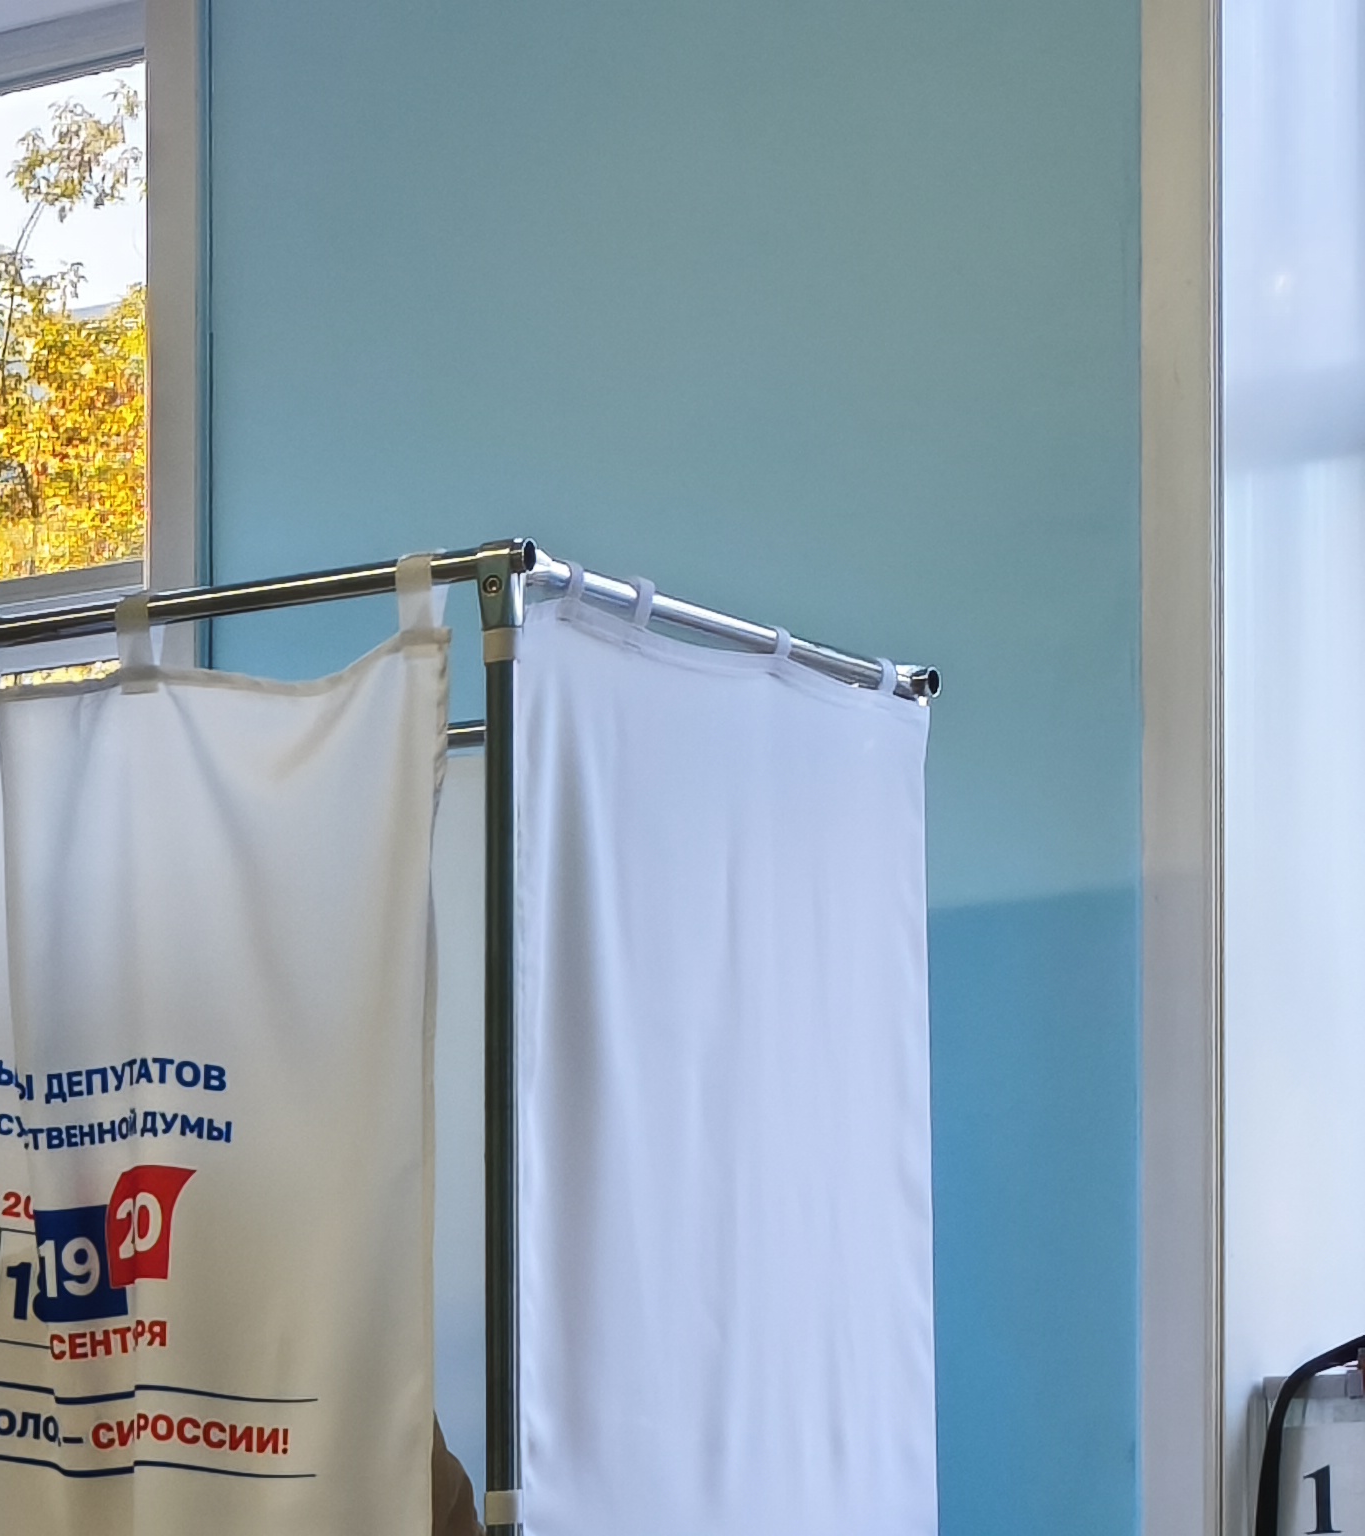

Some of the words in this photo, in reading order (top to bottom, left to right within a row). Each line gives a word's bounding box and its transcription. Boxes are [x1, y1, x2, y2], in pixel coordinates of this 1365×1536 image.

[44, 1057, 227, 1104] ДЕПУТАТОВ
[140, 1111, 232, 1143] ДУМЫ
[116, 1191, 163, 1260] 20
[37, 1236, 101, 1298] 19
[135, 1412, 289, 1455] РОССИИ!
[1302, 1464, 1342, 1535] 1
